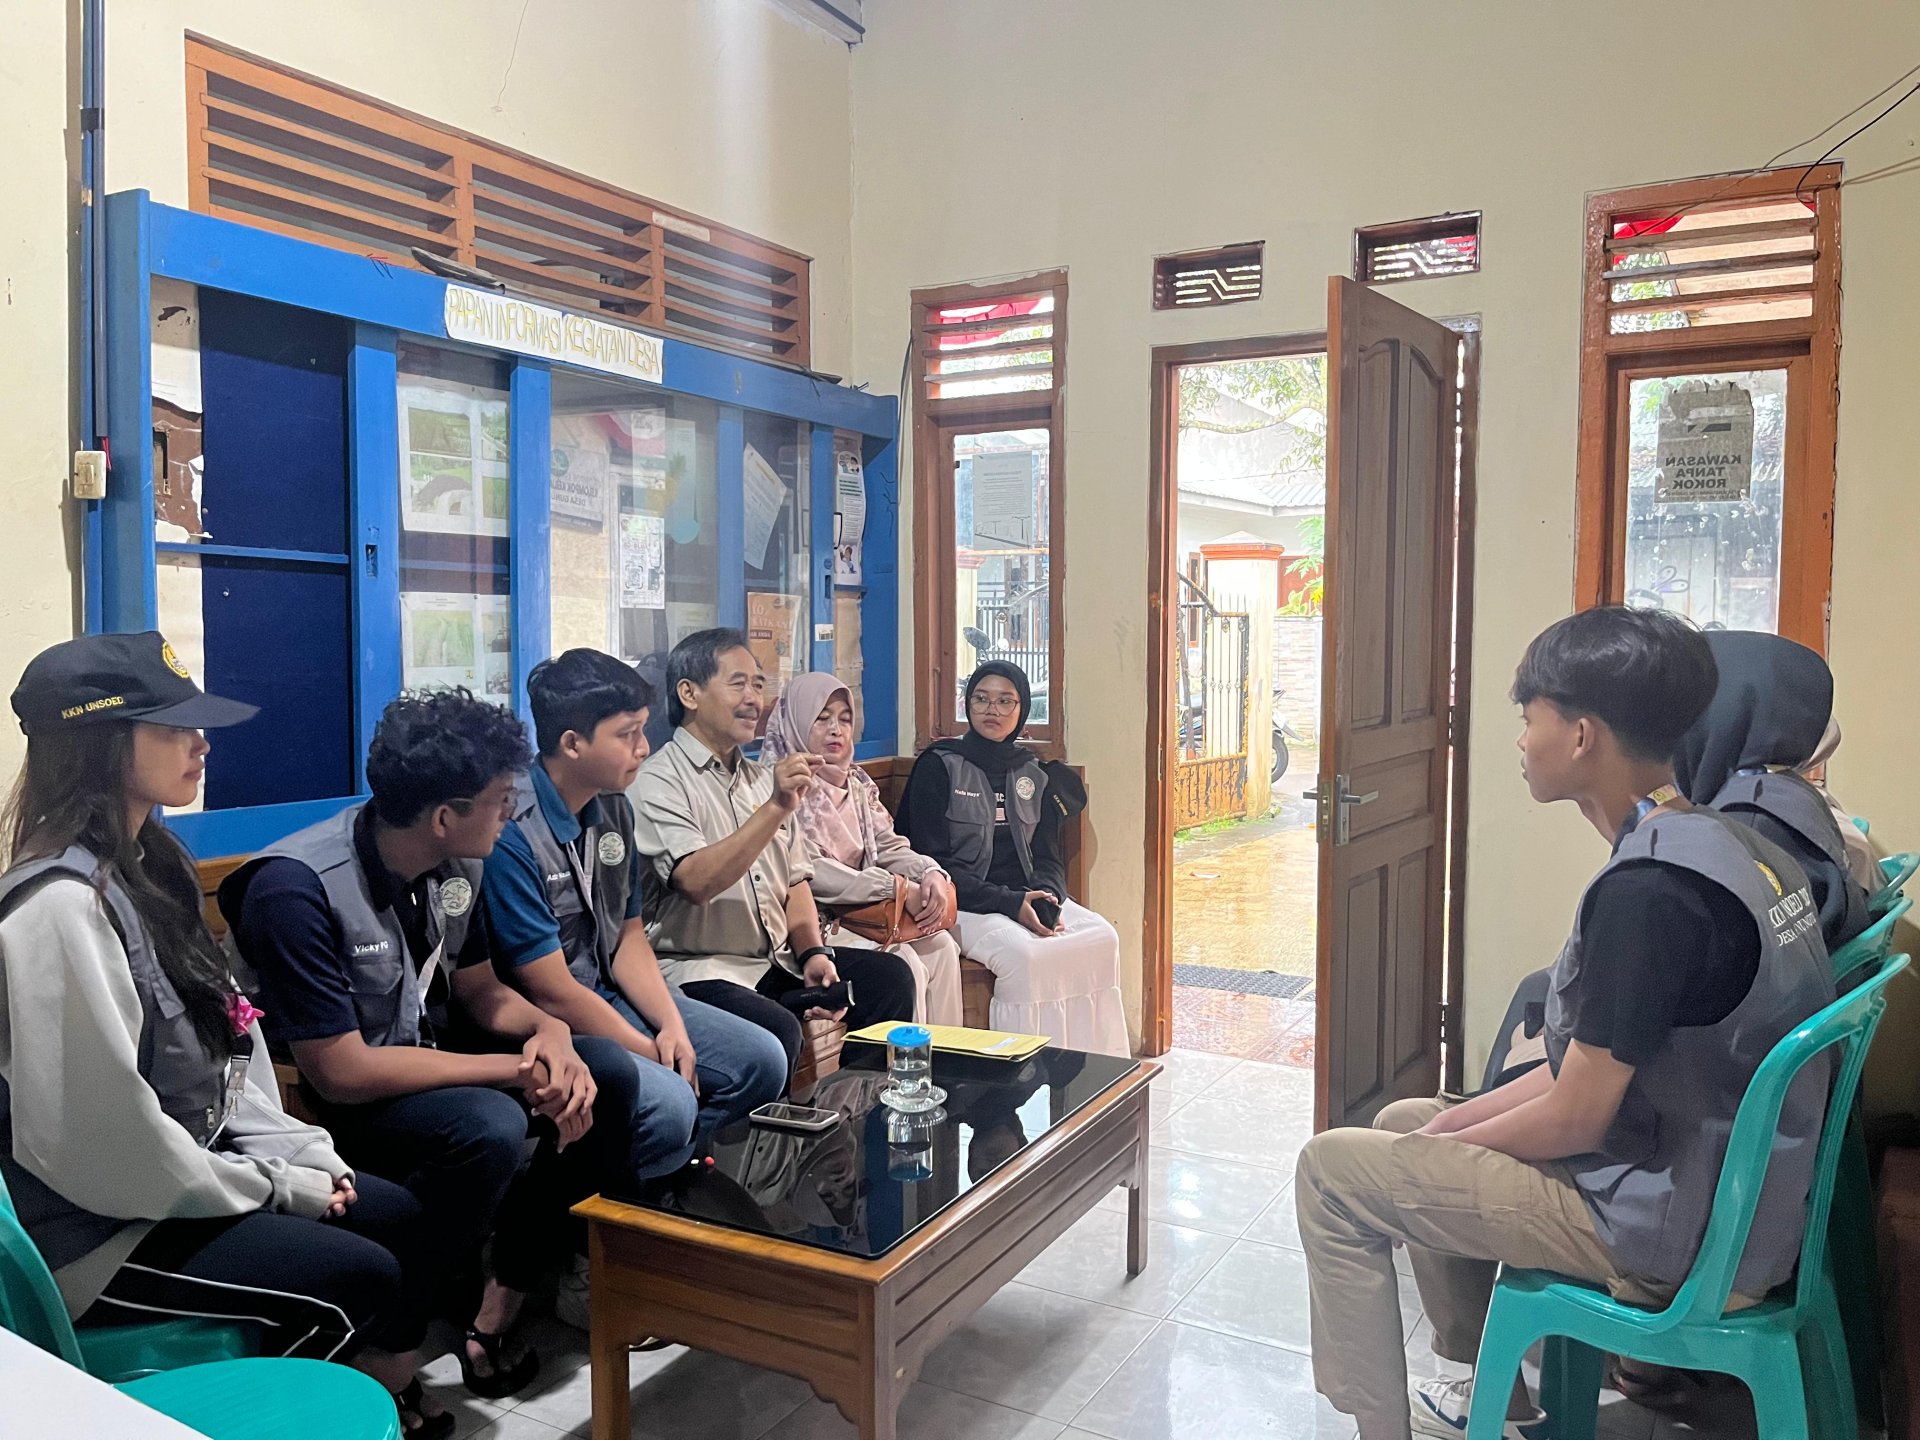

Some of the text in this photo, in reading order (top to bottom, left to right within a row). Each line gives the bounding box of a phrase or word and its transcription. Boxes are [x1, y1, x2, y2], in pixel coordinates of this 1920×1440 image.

[449, 288, 660, 375] PAPAN INFORMASI KEGIATAN DESA
[61, 696, 124, 719] KKN UNSOED
